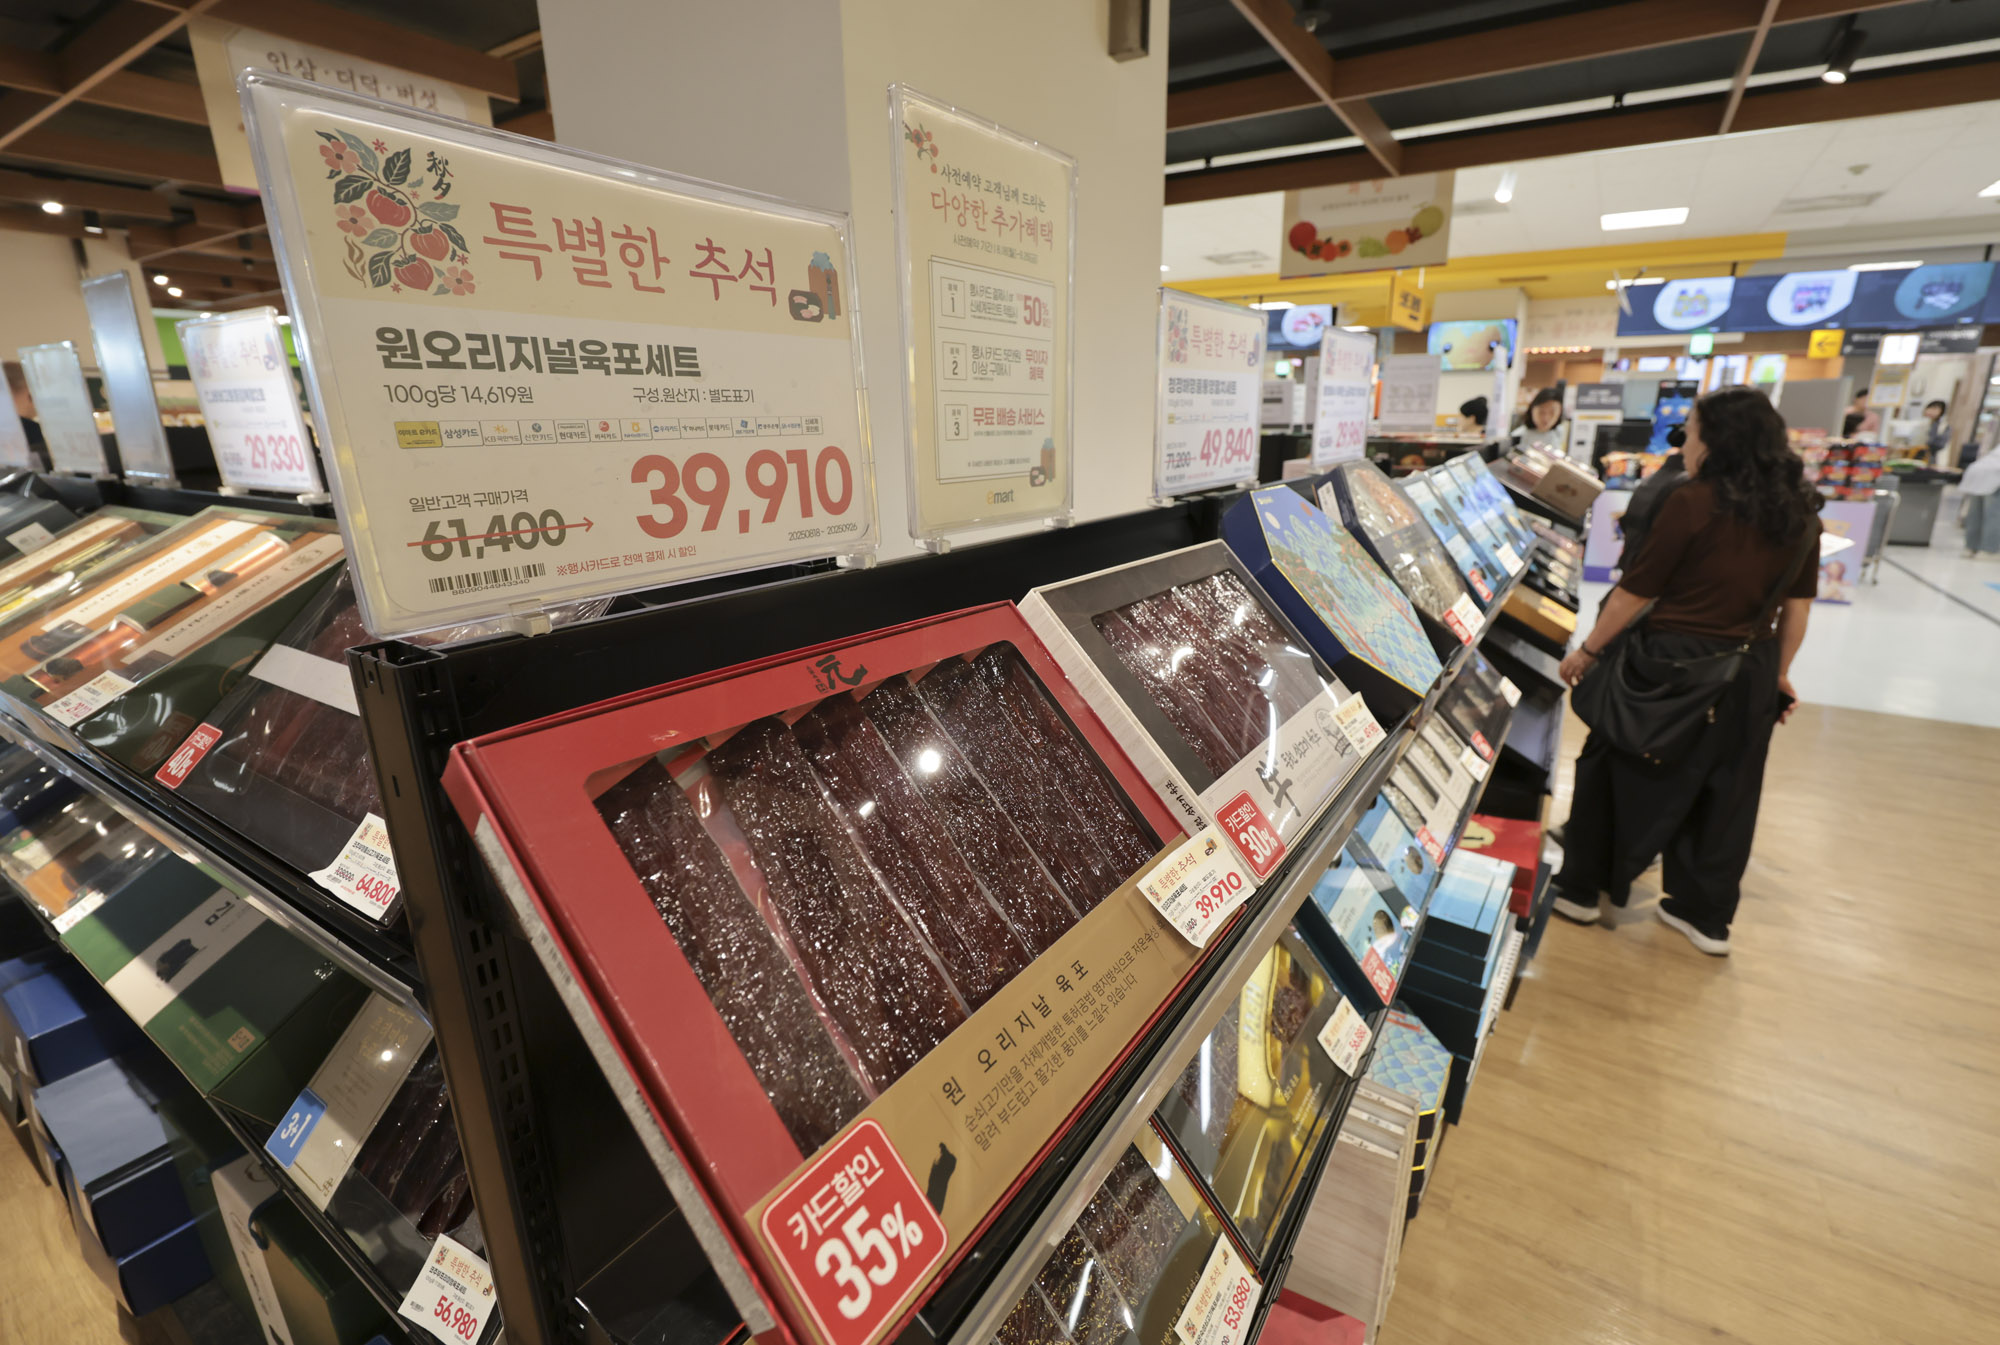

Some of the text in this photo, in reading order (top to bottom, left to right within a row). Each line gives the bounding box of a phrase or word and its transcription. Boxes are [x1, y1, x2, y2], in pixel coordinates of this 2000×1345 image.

[941, 163, 981, 192] 사전예약
[1021, 192, 1047, 213] 드리는
[931, 187, 1053, 251] 다양한 추가혜택
[483, 201, 777, 307] 특별한 추석
[375, 326, 702, 378] 원오리지널육포세트
[952, 360, 958, 375] 2
[971, 361, 988, 376] 이상
[383, 384, 534, 408] 100g당 14,619원
[709, 388, 755, 403] 별도표기
[444, 428, 479, 439] 삼성카드
[954, 421, 960, 436] 3
[973, 407, 1045, 426] 무료 배송 서비스
[245, 434, 305, 473] 29,330
[1200, 427, 1254, 468] 49,840
[409, 489, 529, 513] 일반고객 구매가격
[631, 446, 853, 539] 39,910
[421, 508, 567, 562] 61,400
[622, 553, 643, 566] 전액
[645, 549, 665, 563] 결제
[668, 547, 676, 559] 시
[678, 545, 697, 557] 할인
[1165, 779, 1178, 795] 육포
[1176, 795, 1196, 816] 쇠고기
[1225, 801, 1257, 833] 카드할인
[1239, 824, 1279, 864] 30%
[355, 873, 396, 905] 64,800
[1158, 865, 1181, 890] 특별한
[1178, 852, 1198, 873] 추석
[1195, 871, 1242, 919] 39,910
[1020, 1024, 1066, 1071] 자체개발한
[1062, 991, 1094, 1028] 특허공법
[1092, 951, 1136, 994] 염지방식으로
[1131, 925, 1161, 957] 저온숙성
[942, 1076, 966, 1106] 원
[1055, 959, 1089, 993] 육포
[996, 1081, 1039, 1128] 부드럽고
[1034, 1052, 1065, 1087] 쫄깃한
[1060, 1027, 1090, 1059] 풍미를
[1106, 973, 1139, 1009] 있습니다
[280, 1112, 312, 1148] 3+1
[787, 1145, 884, 1250] 카드할인
[450, 1256, 483, 1288] 특별한 추석
[815, 1201, 924, 1320] 35%
[434, 1294, 478, 1341] 56,980
[1224, 1276, 1251, 1331] 53,880
